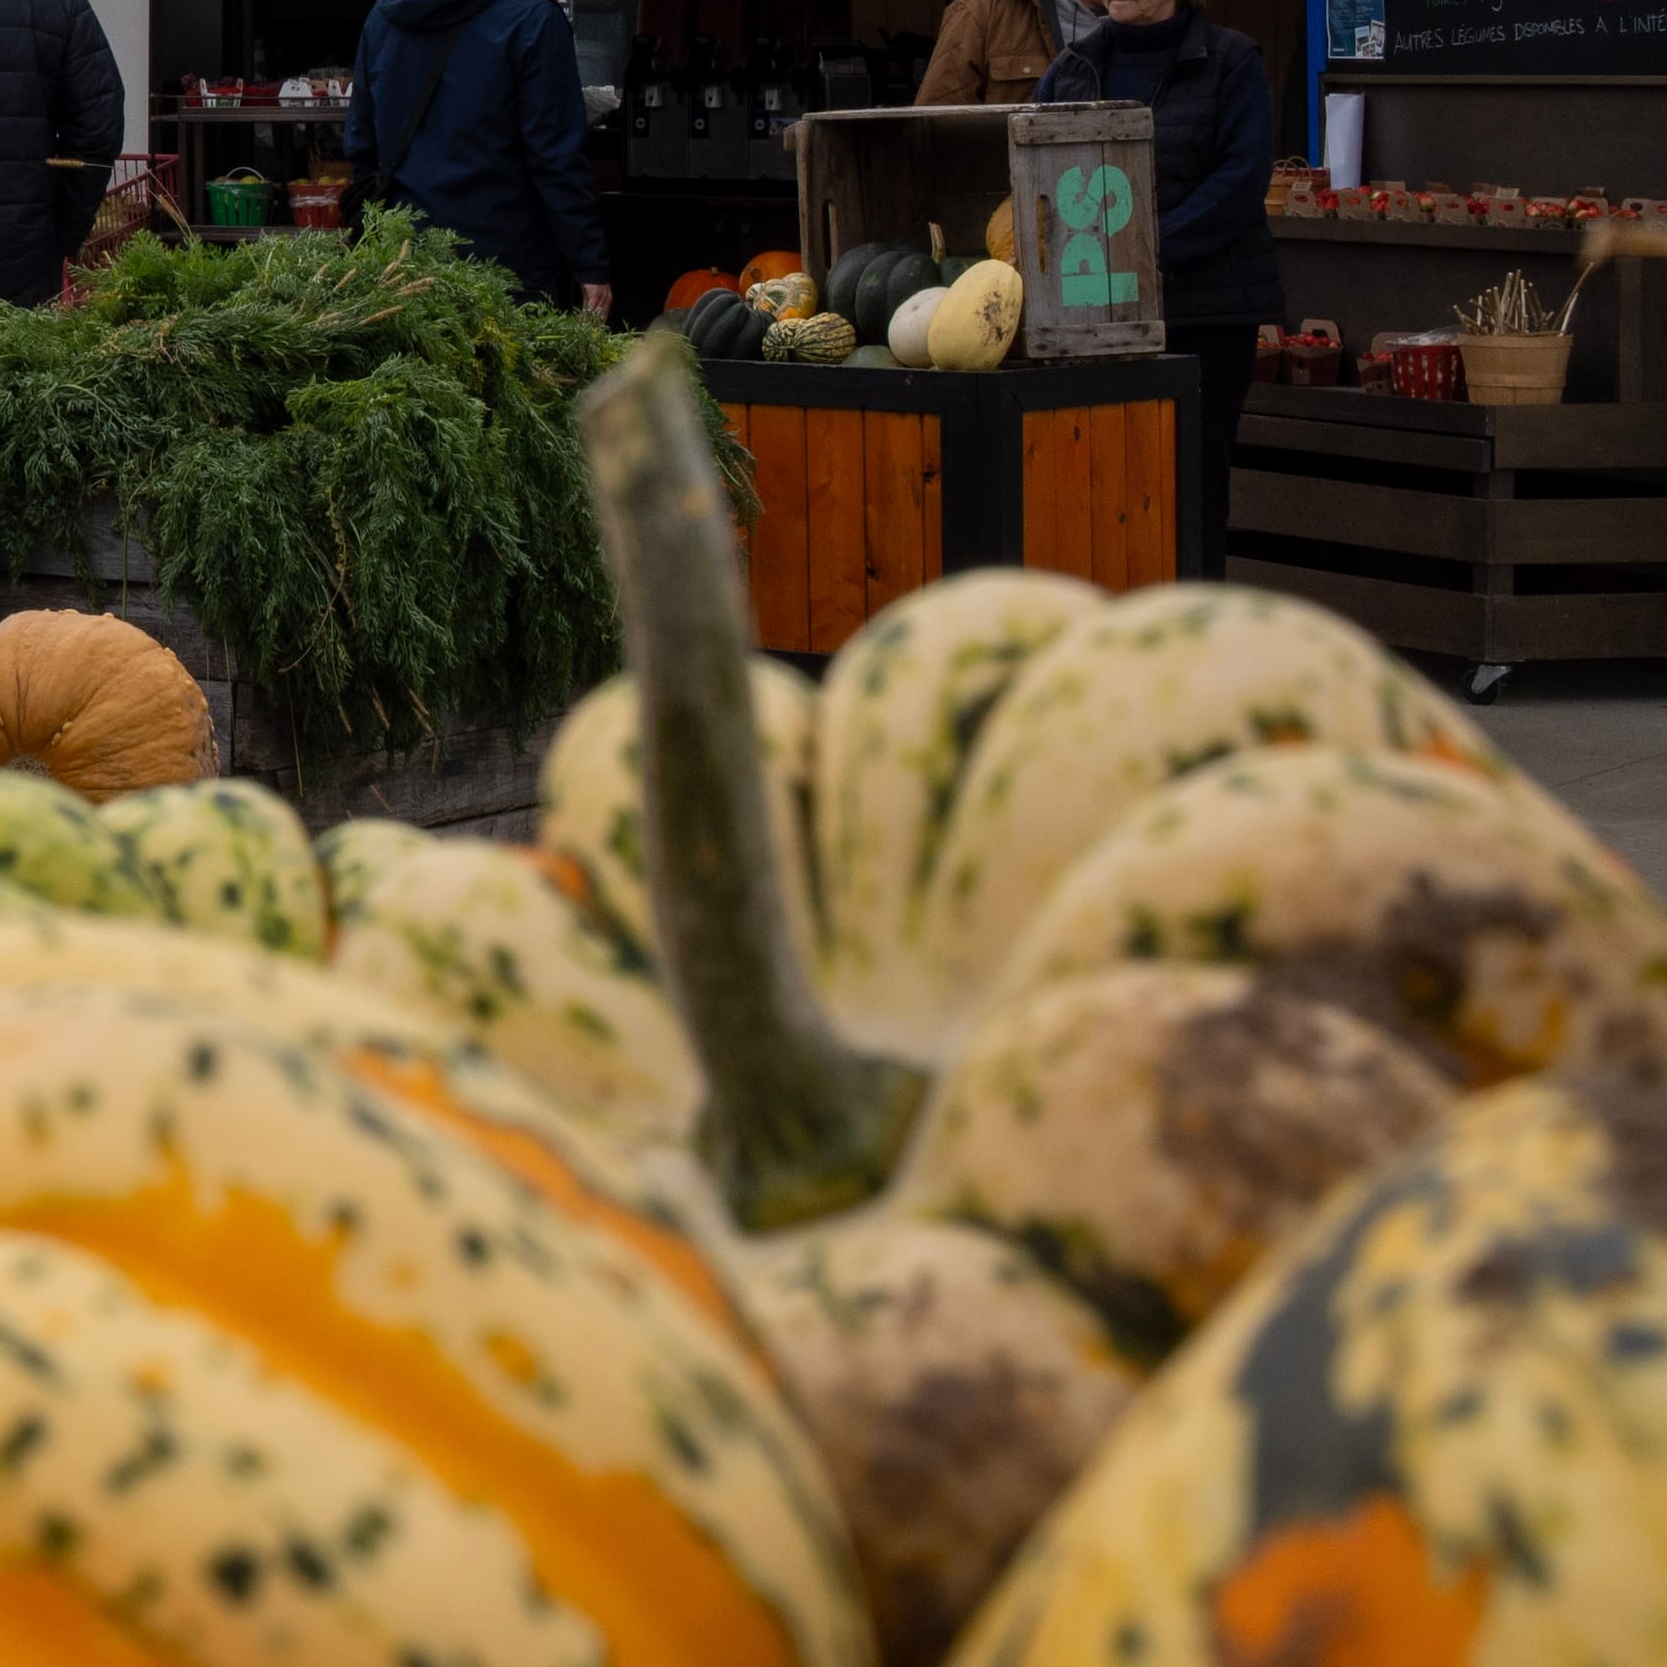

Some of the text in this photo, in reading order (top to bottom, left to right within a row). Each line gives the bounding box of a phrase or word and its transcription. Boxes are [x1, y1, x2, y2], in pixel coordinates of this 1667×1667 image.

[1394, 28, 1444, 55] AUTRES
[1451, 23, 1506, 46] LÉGUMES
[1512, 17, 1586, 42] DISPONIBLES
